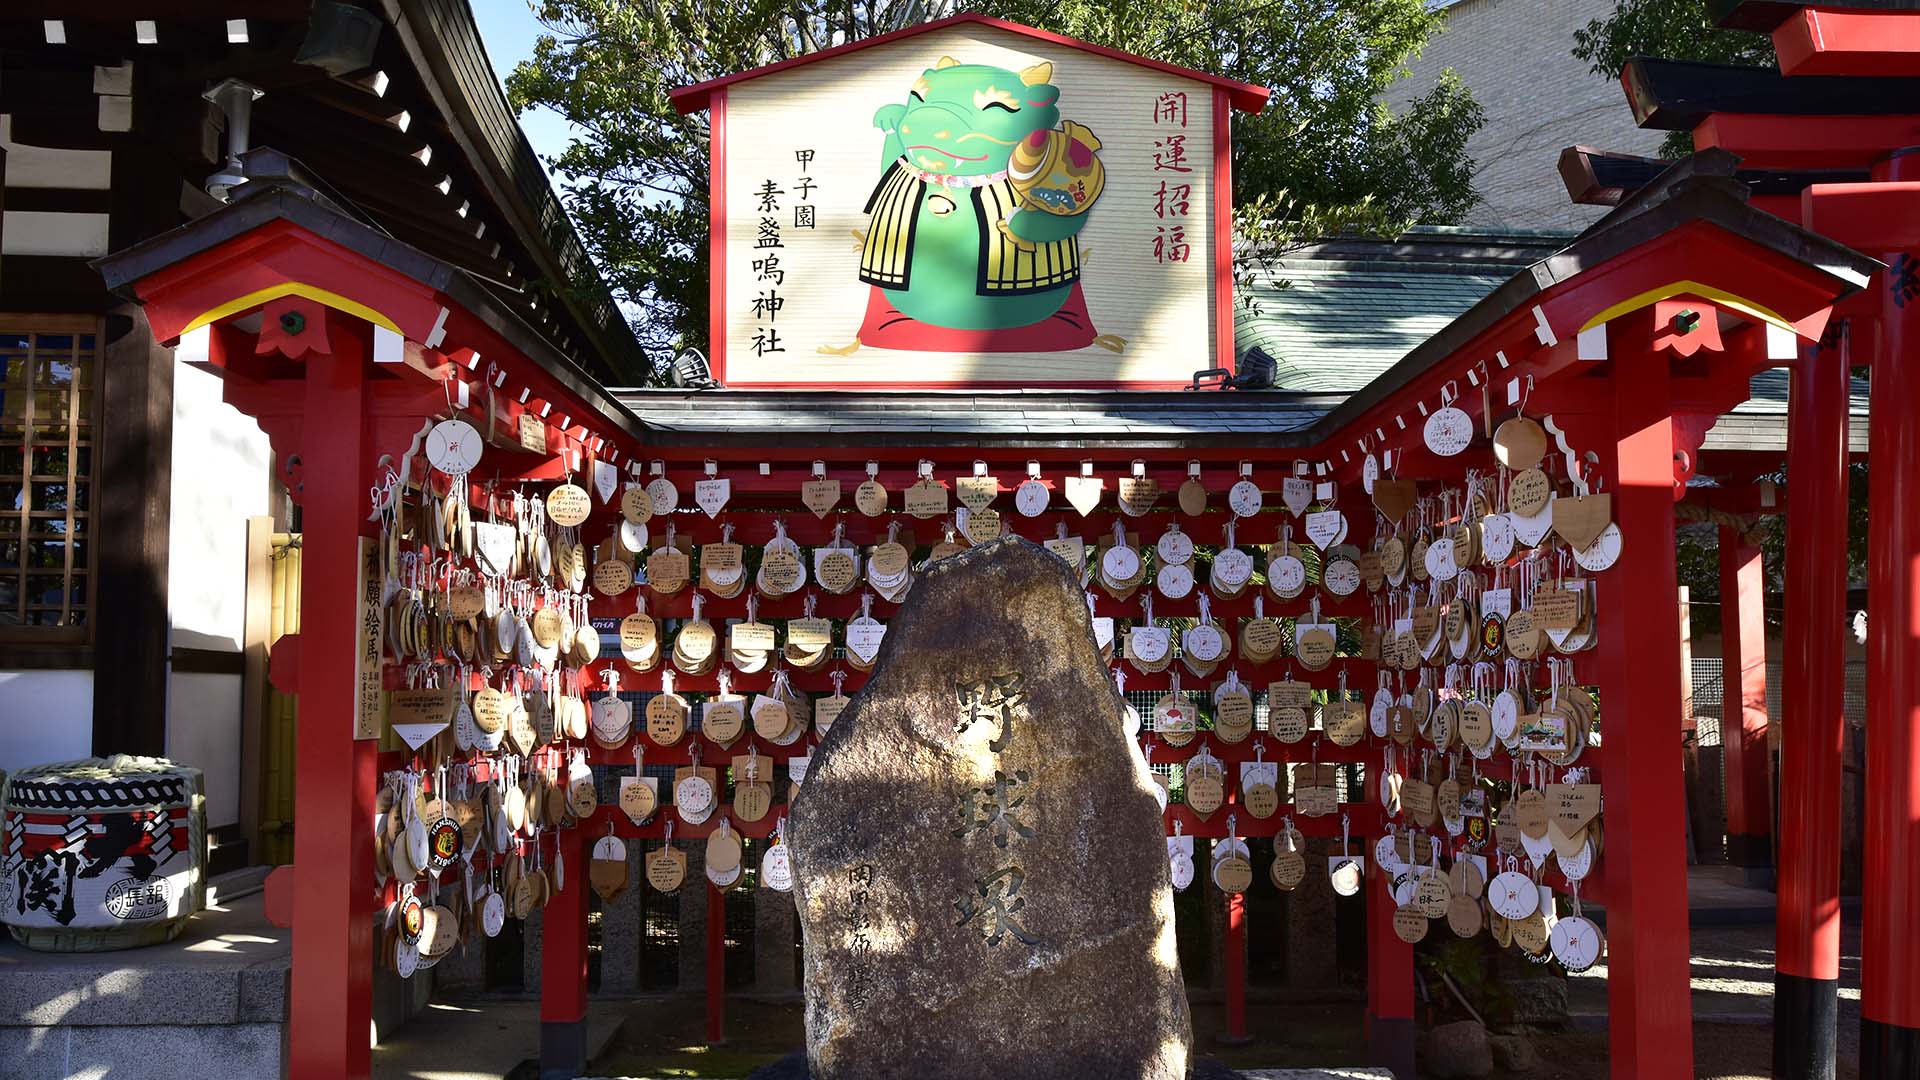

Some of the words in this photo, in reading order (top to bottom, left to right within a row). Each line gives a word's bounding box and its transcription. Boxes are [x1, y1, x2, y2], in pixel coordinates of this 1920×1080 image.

[793, 149, 817, 230] 甲子園
[1151, 91, 1192, 264] 開運招福
[750, 179, 786, 358] 素盞嗚神社
[364, 546, 381, 670] 祈願絵馬
[953, 671, 1042, 946] 野球塚
[125, 884, 163, 907] 長部
[433, 853, 459, 867] Tigers
[1419, 894, 1445, 905] 日本一
